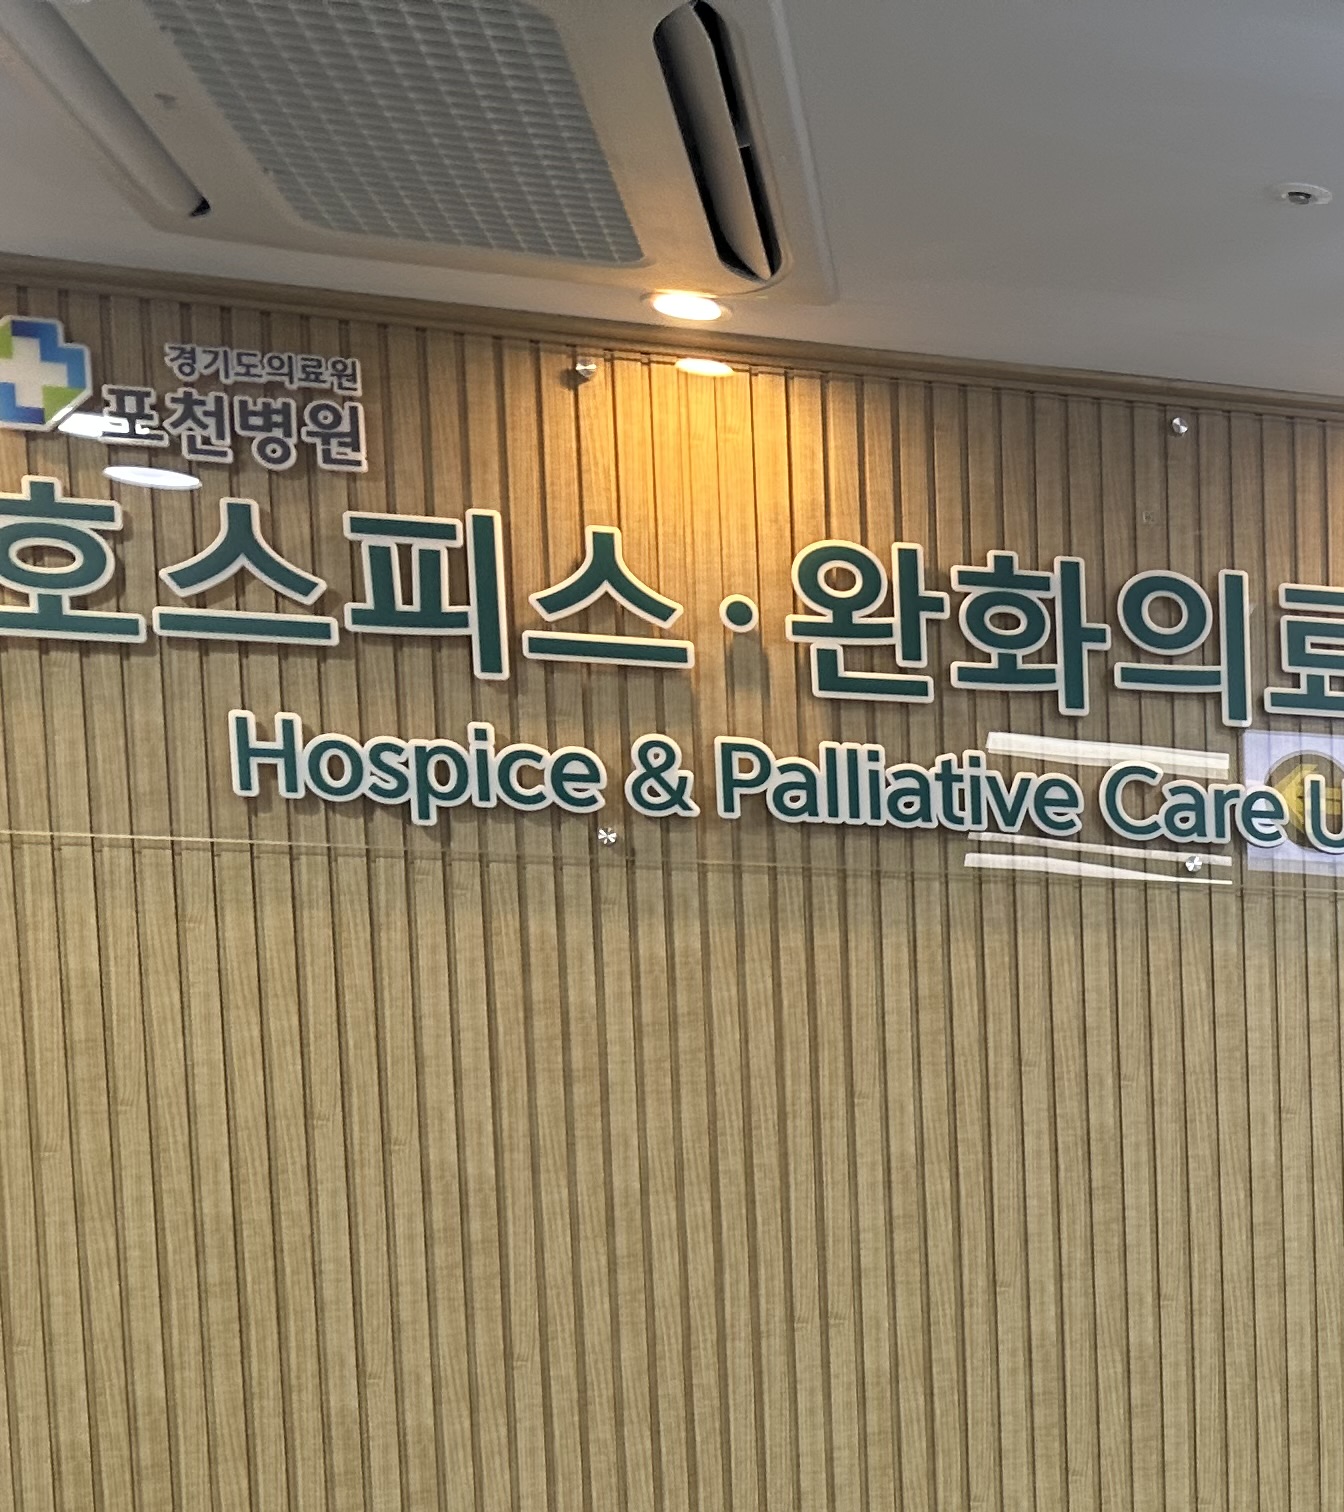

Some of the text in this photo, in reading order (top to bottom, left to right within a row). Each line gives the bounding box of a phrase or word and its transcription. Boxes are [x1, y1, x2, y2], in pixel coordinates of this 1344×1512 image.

[164, 342, 362, 396] 경기도의료원
[99, 384, 368, 473] 포천병원
[229, 709, 607, 826] Hospice
[625, 733, 700, 817] &
[714, 736, 1083, 833] Palliative
[1099, 761, 1288, 846] Care
